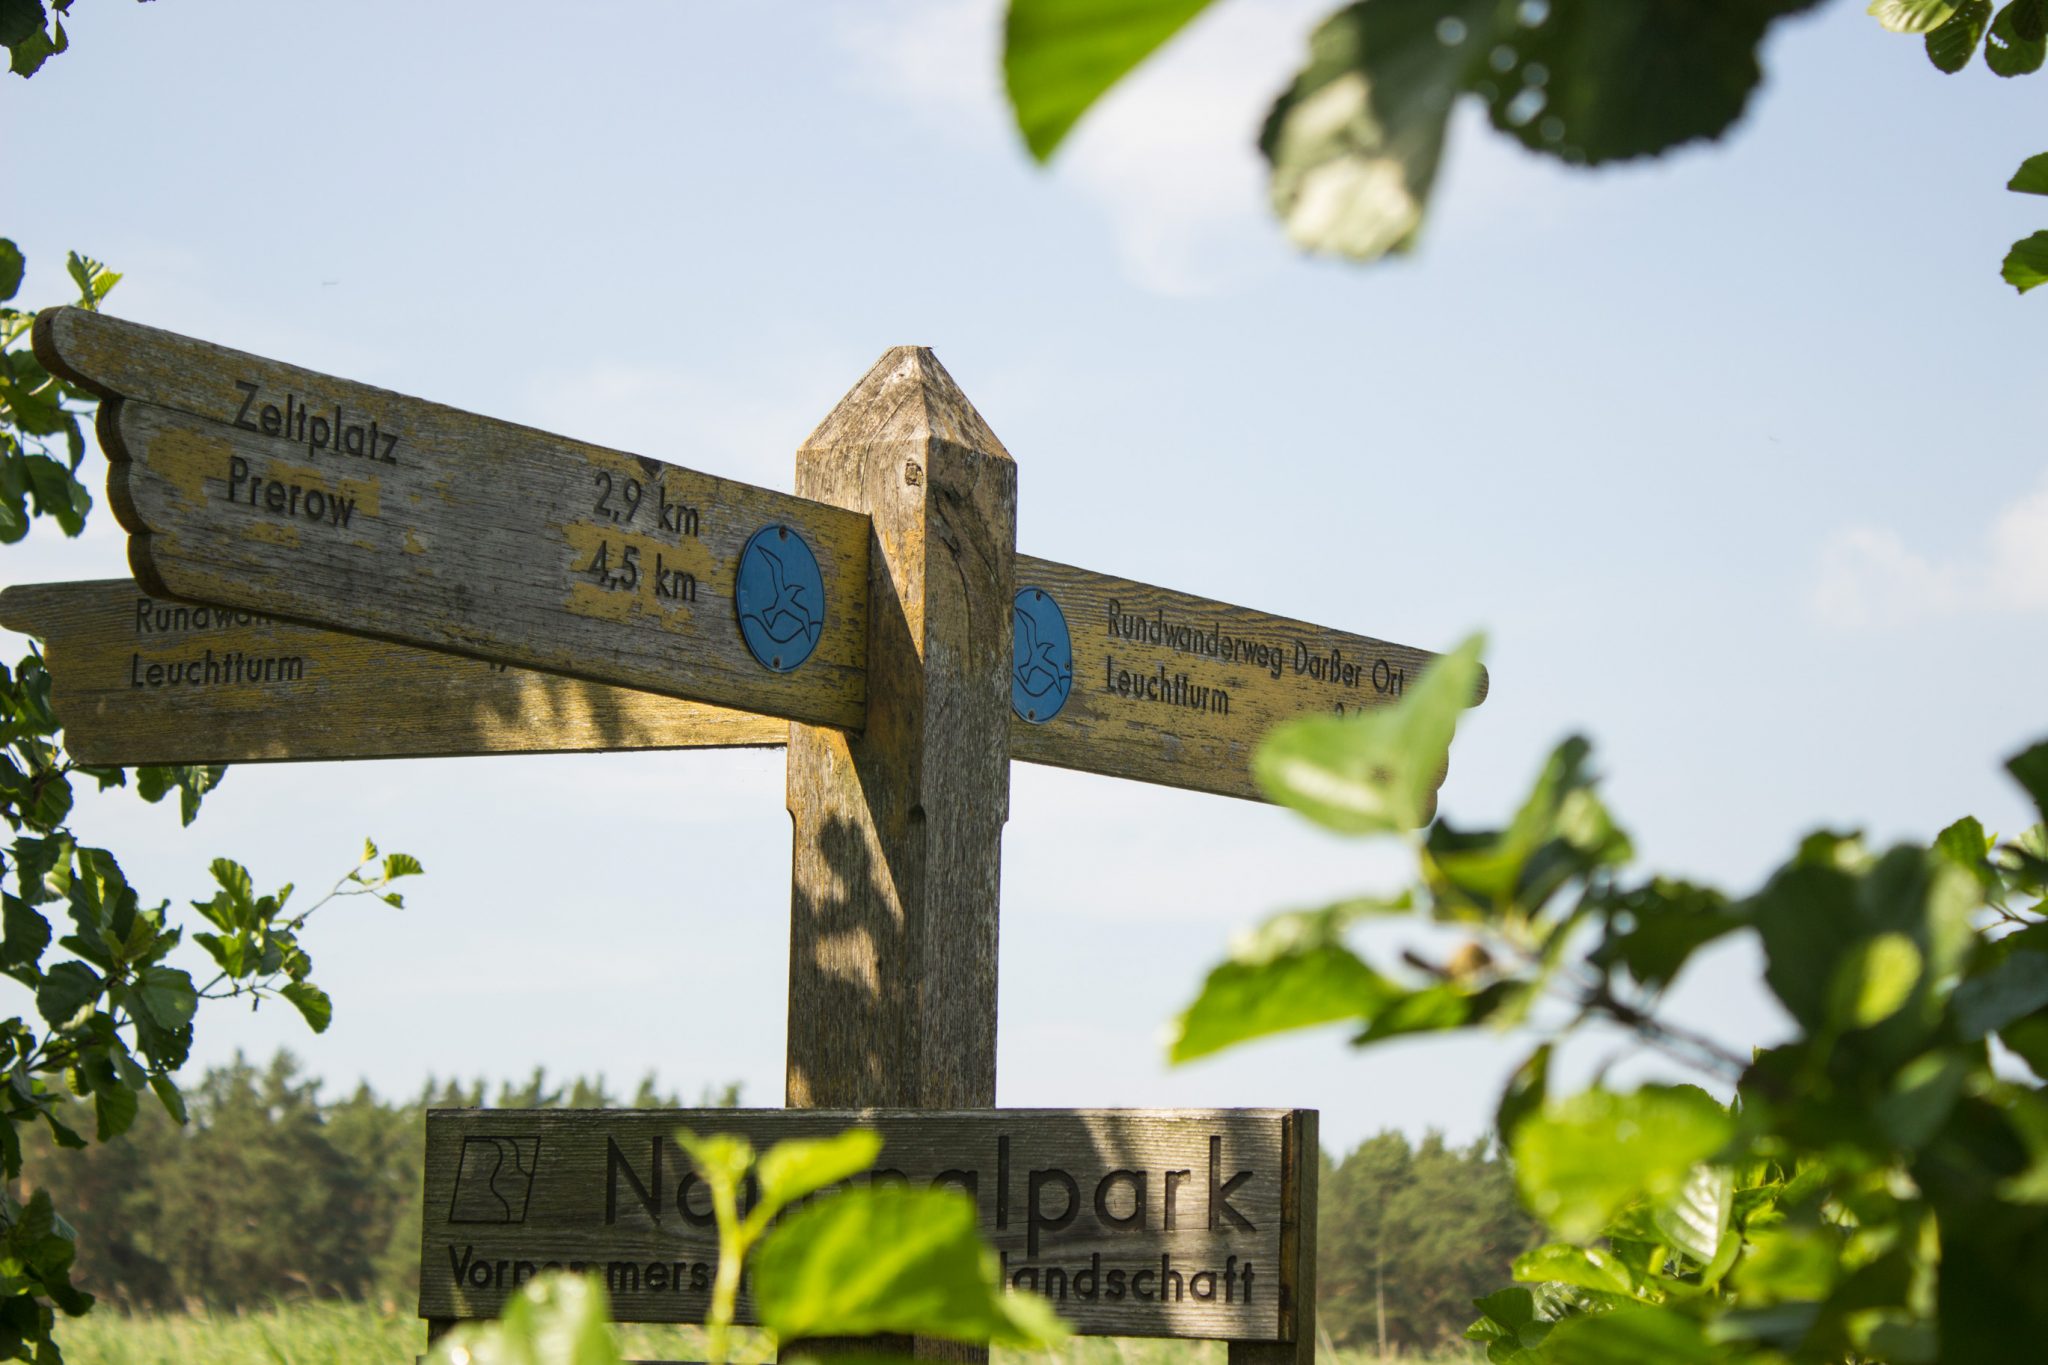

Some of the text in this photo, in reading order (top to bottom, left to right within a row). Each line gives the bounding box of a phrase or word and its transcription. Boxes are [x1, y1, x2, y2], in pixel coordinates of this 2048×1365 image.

[233, 379, 698, 537] Zeltplatz 2,9 km
[228, 455, 695, 602] Prerow 4,5 km
[131, 649, 303, 689] Leuchtturm
[1106, 655, 1229, 715] Leuchtturm
[1108, 598, 1404, 699] Rundwanderweg Darßer Ort
[605, 1134, 1258, 1258] Nalpark
[999, 1250, 1255, 1303] landschaft
